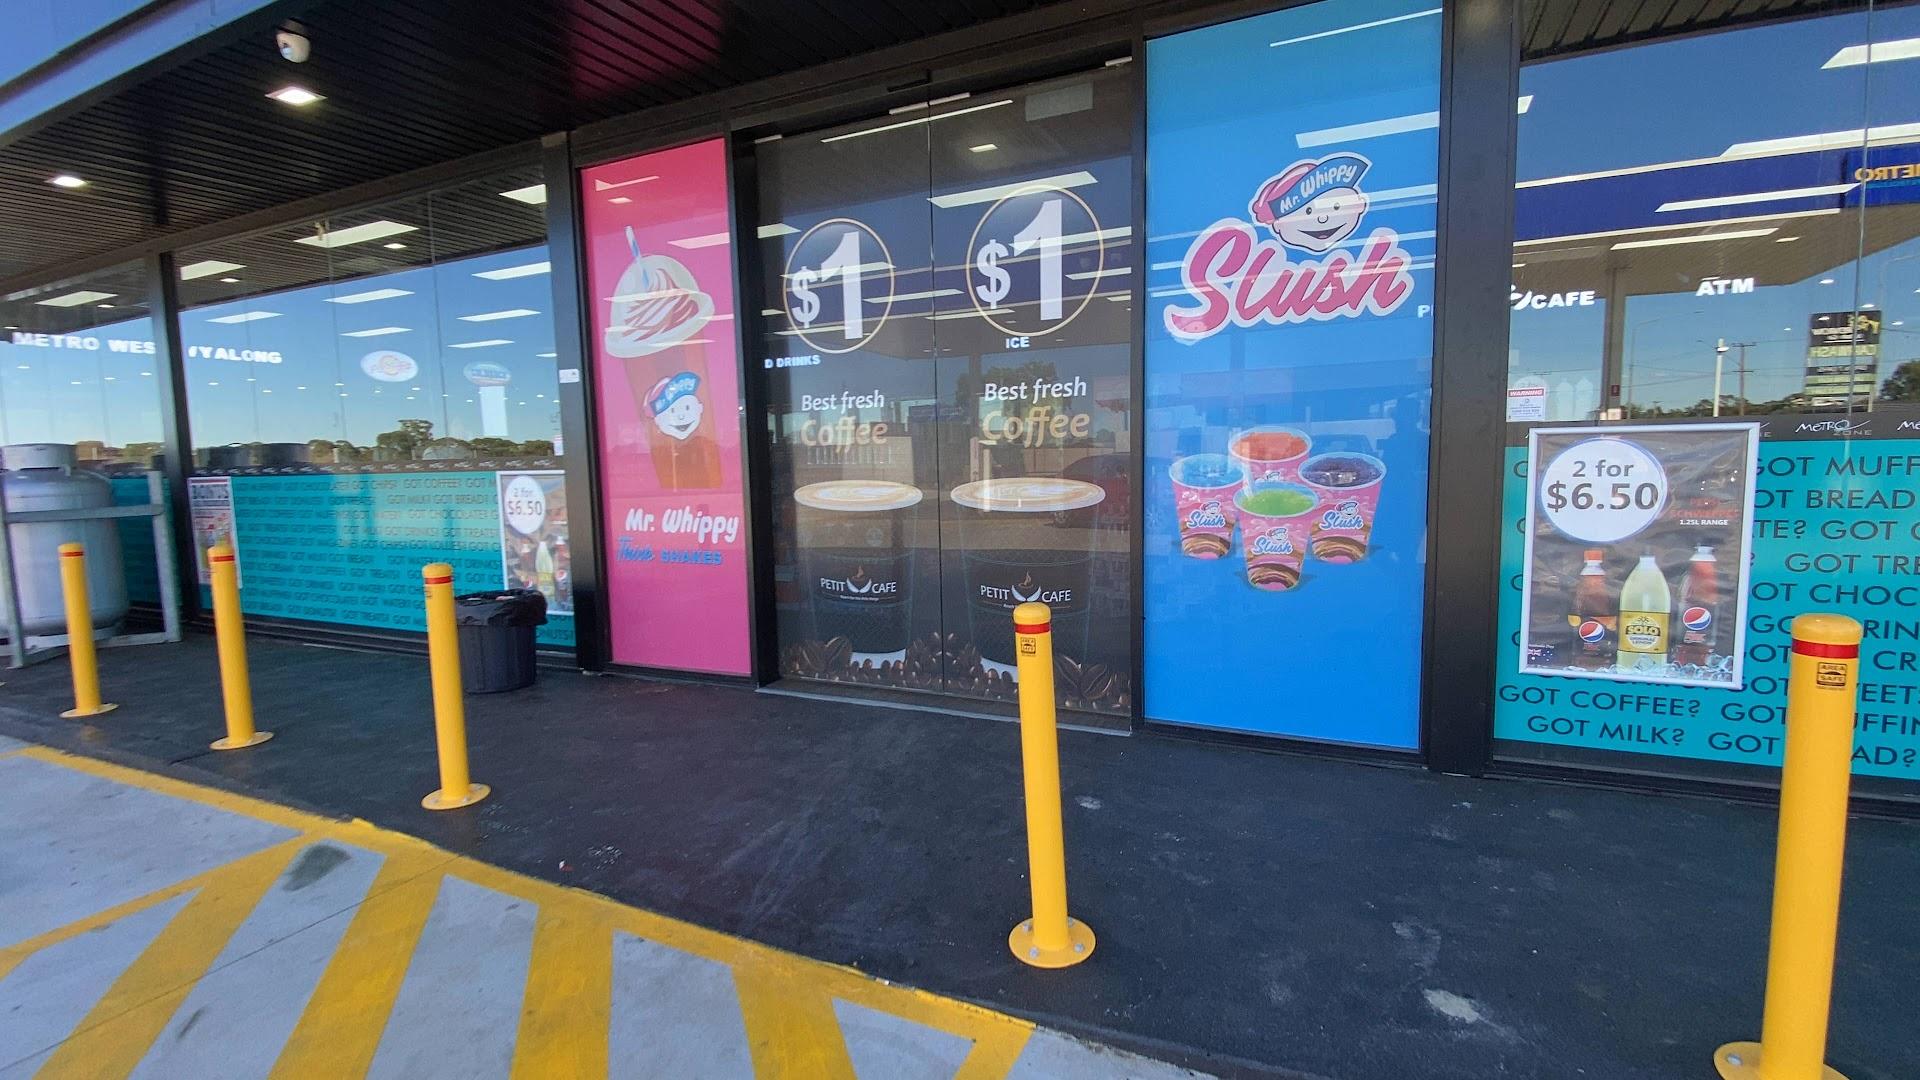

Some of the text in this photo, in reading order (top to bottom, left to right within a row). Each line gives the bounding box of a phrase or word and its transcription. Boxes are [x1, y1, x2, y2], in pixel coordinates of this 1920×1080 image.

[1279, 163, 1358, 215] Mr. Whippy
[976, 199, 1063, 321] $1
[791, 231, 863, 339] $1
[1168, 224, 1408, 335] Slush
[1695, 277, 1755, 297] ATM
[1530, 290, 1596, 310] CAFE
[11, 331, 99, 351] METRO
[1005, 336, 1030, 349] ICE
[775, 354, 821, 368] DRINKS
[983, 375, 1088, 405] Best fresh
[1510, 389, 1543, 397] WARNING
[801, 390, 885, 414] Best fresh
[800, 415, 888, 454] Coffee
[982, 405, 1090, 448] Coffee
[1572, 460, 1635, 478] 2 for
[1546, 480, 1660, 513] $6.50
[1806, 489, 1916, 510] BREAD
[507, 500, 543, 516] $6.50
[625, 506, 739, 544] Mr. Whippy
[1188, 511, 1225, 528] Slush
[1321, 510, 1363, 529] Slush
[1820, 520, 1898, 541] GOT
[1253, 536, 1292, 554] Slush
[1784, 553, 1861, 574] GOT
[820, 577, 897, 594] PETIT CAFE
[980, 585, 1071, 603] PETIT CAFE
[1627, 625, 1659, 636] SOLO
[1819, 674, 1845, 682] SAFE
[1820, 664, 1846, 672] AREA
[1499, 685, 1560, 705] GOT
[1570, 691, 1701, 717] COFFEE?
[1527, 716, 1590, 737] GOT
[1599, 722, 1685, 746] MILK?
[1708, 732, 1781, 756] GOT
